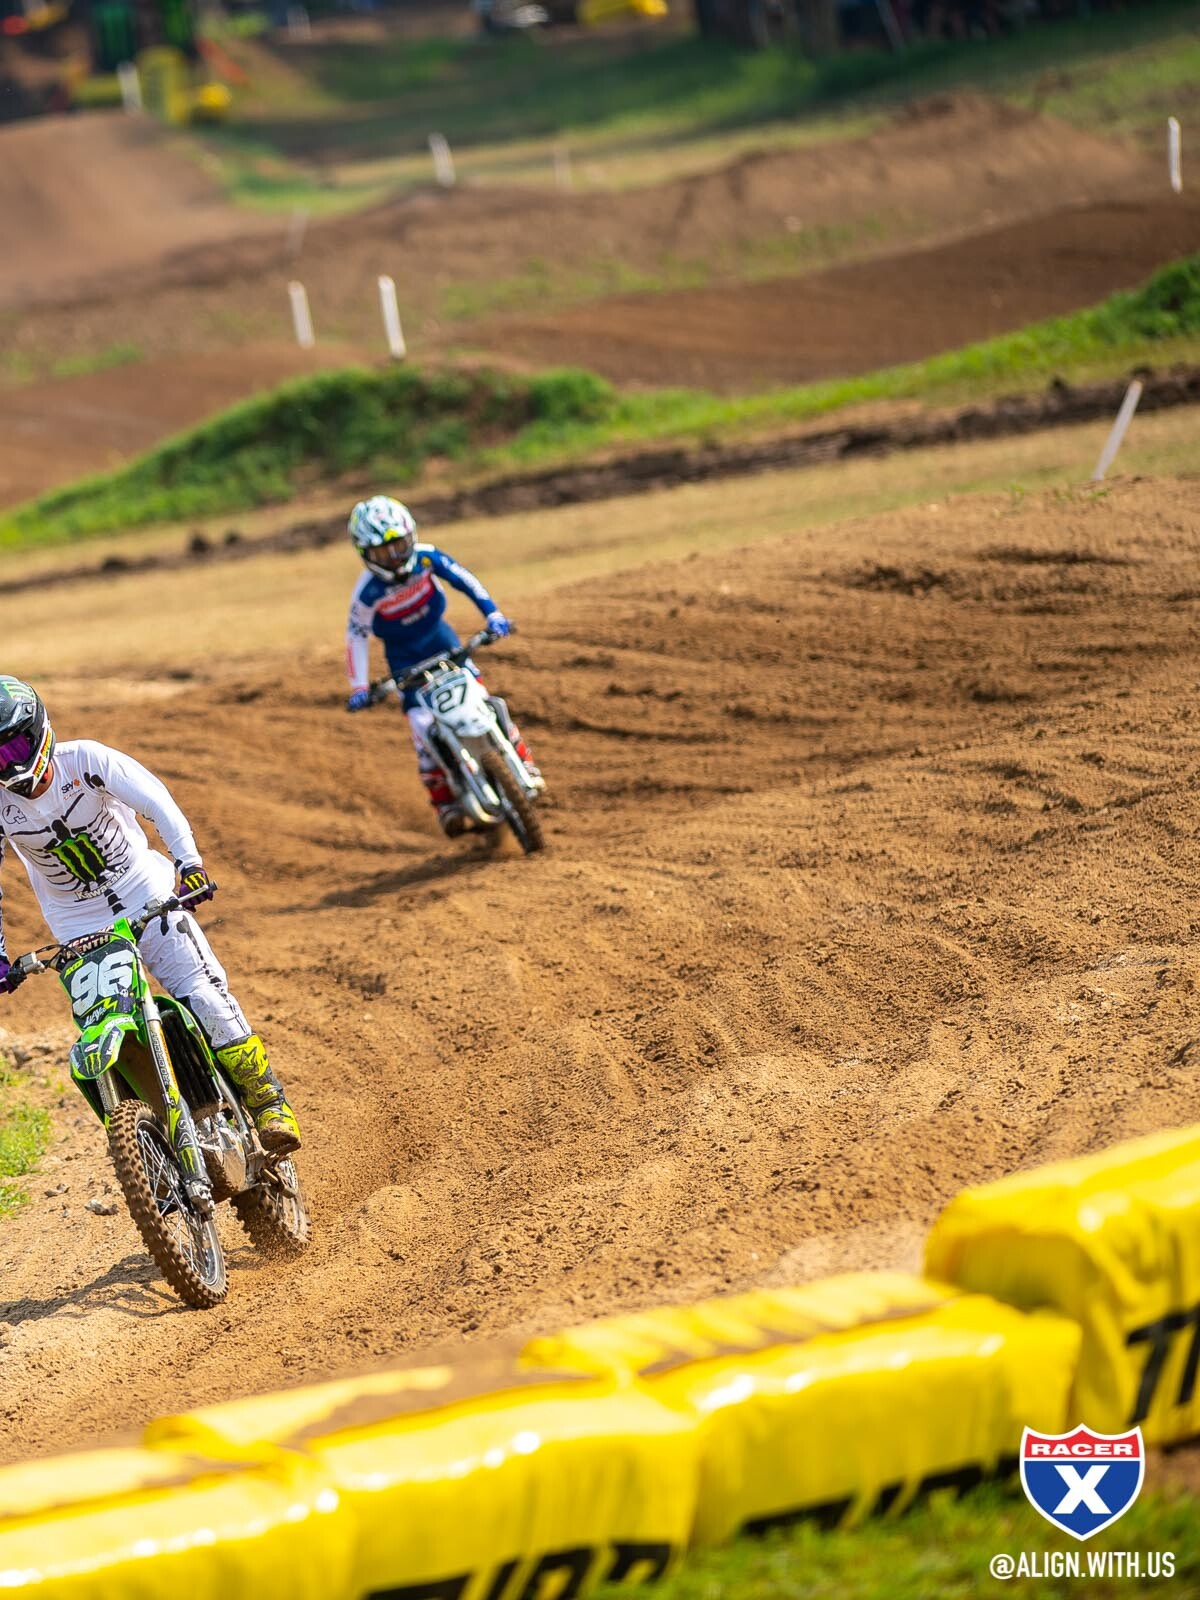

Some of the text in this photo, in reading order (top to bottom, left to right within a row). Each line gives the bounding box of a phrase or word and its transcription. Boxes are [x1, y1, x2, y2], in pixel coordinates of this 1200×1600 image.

[435, 682, 468, 714] 27
[75, 865, 128, 901] Kawasaki
[70, 949, 134, 1017] 96
